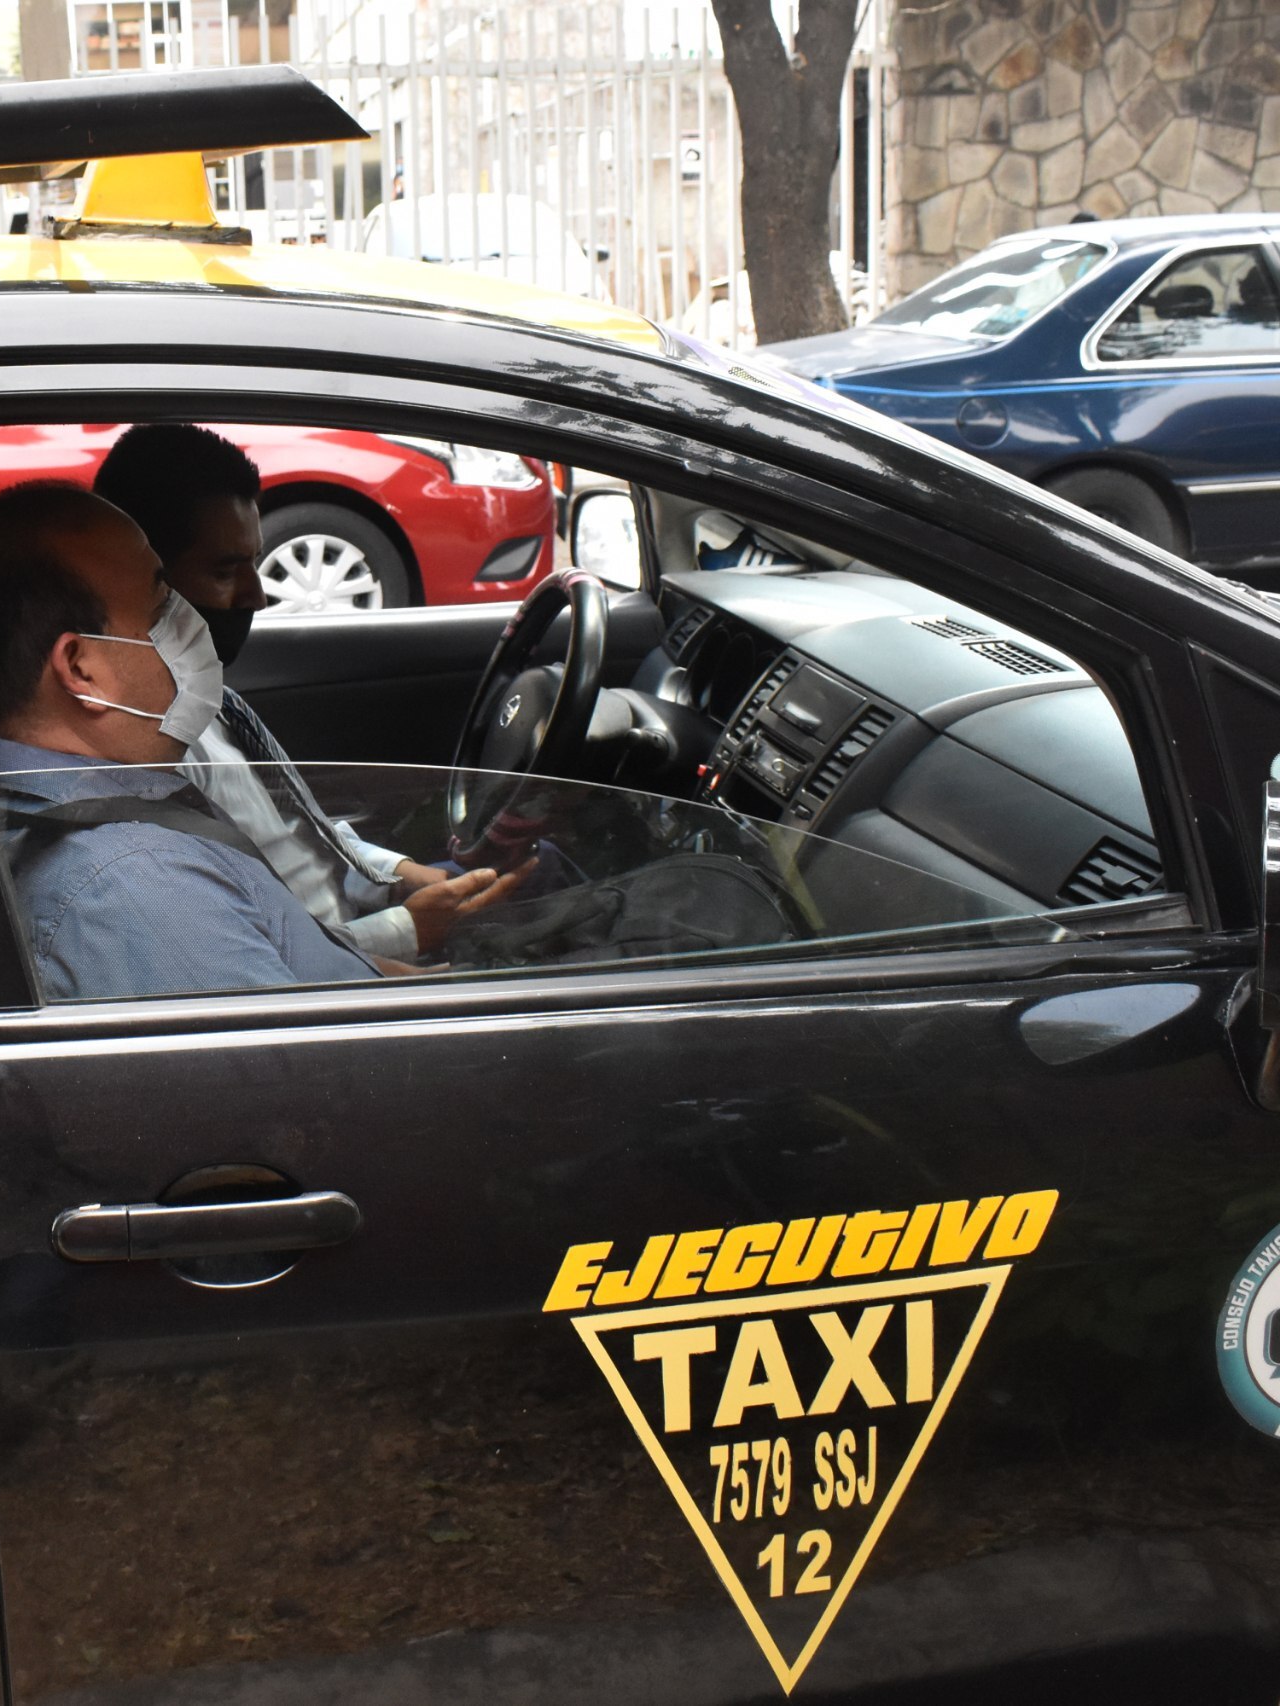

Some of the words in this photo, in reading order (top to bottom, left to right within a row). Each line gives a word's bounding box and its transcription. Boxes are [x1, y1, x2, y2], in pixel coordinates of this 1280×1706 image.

[542, 1189, 1059, 1312] EJECUTIVO
[1223, 1278, 1255, 1350] CONSEJO
[634, 1300, 933, 1432] TAXI
[710, 1437, 791, 1523] 7579
[814, 1427, 877, 1511] SSJ
[758, 1530, 831, 1598] 12
